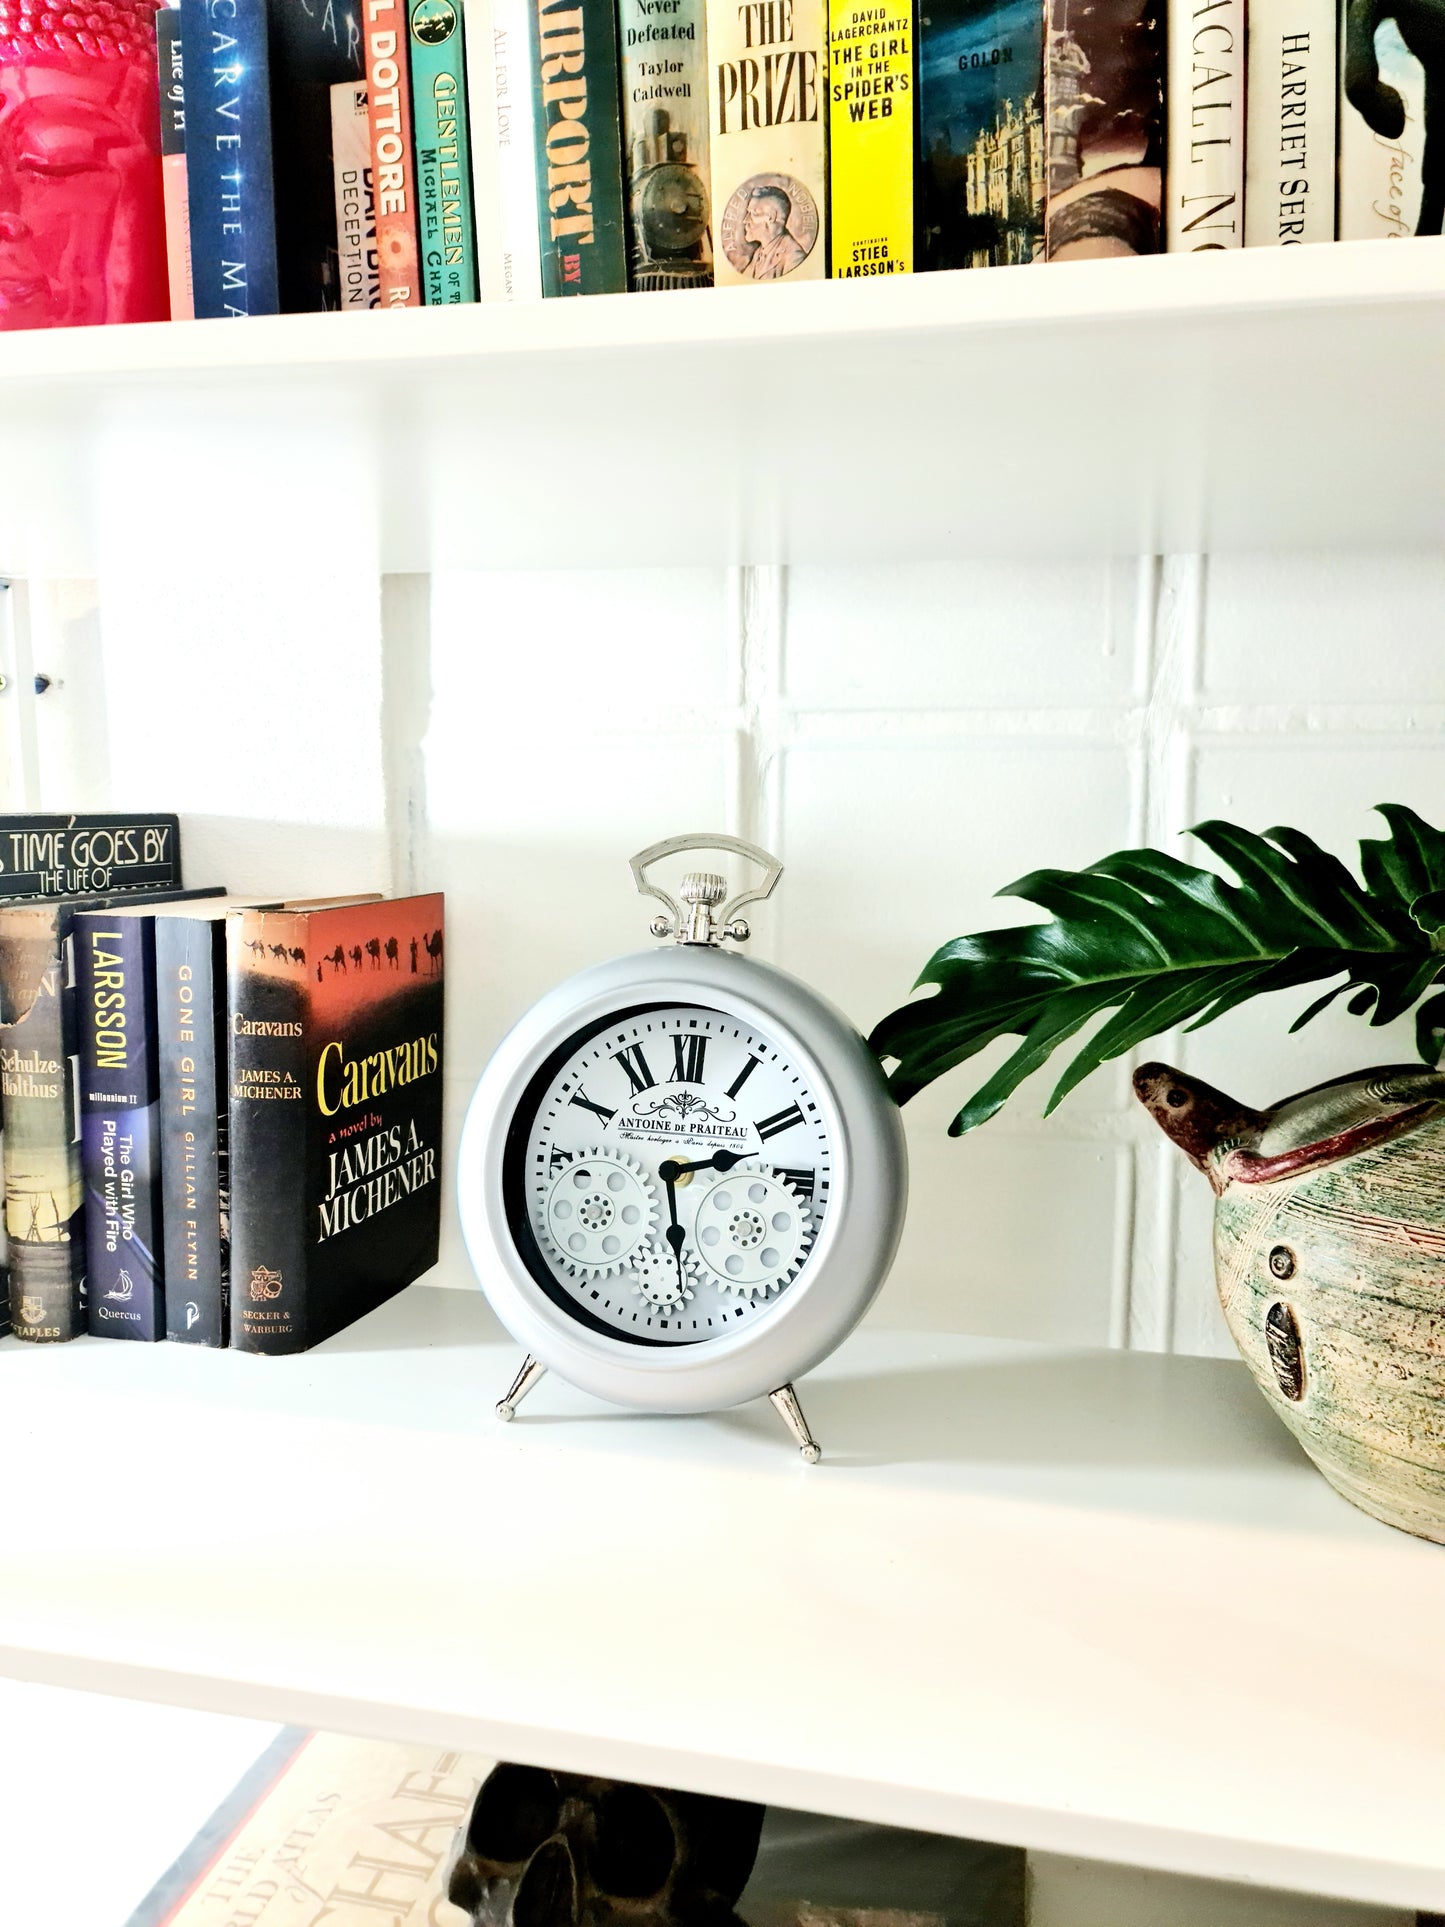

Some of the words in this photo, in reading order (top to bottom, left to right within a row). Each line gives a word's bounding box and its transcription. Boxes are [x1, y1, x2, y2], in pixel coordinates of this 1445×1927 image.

[636, 0, 682, 18] Never
[738, 0, 794, 48] THE
[852, 8, 887, 24] DAVID
[627, 23, 696, 47] Defeated
[831, 19, 909, 42] LAGERCRANTZ
[639, 59, 684, 76] Taylor
[833, 45, 863, 65] THE
[870, 38, 909, 59] GIRL
[211, 0, 243, 152] CARVE
[851, 66, 863, 78] IN
[868, 60, 890, 74] THE
[633, 83, 691, 103] Caldwell
[718, 51, 819, 135] PRIZE
[833, 74, 909, 101] SPIDER'S
[1280, 31, 1311, 170] HARRIET
[369, 31, 407, 217] DOTTORE
[850, 97, 893, 123] WEB
[421, 149, 438, 240] MICHAEL
[432, 72, 464, 266] GENTLEMEN
[448, 271, 461, 288] OF
[220, 174, 243, 236] THE
[722, 187, 749, 252] ALFRED
[788, 183, 815, 234] NOBEL
[341, 170, 364, 304] DECEPTION
[852, 245, 888, 262] STIEG
[562, 254, 582, 285] BY
[9, 832, 66, 872] TIME
[71, 829, 139, 868] GOES
[144, 828, 169, 863] BY
[38, 870, 64, 893] THE
[67, 868, 89, 891] LIFE
[91, 867, 113, 889] OF
[92, 932, 128, 1069] LARSSON
[178, 965, 194, 1042] GONE
[232, 1012, 303, 1037] Caravans
[240, 1069, 280, 1083] JAMES
[284, 1070, 297, 1083] A.
[316, 1032, 438, 1117] Caravans
[609, 1041, 660, 1100] XI
[665, 1034, 713, 1085] XII
[1, 1073, 58, 1098] Holthus
[180, 1056, 196, 1116] GIRL
[233, 1086, 302, 1099] MICHENER
[328, 1132, 337, 1144] a
[340, 1120, 367, 1138] novel
[370, 1112, 383, 1128] by
[618, 1117, 672, 1131] ANTOINE
[674, 1123, 686, 1132] DE
[689, 1123, 748, 1138] PRAITEAU
[100, 1119, 117, 1178] Played
[119, 1134, 134, 1164] The
[325, 1125, 401, 1201] JAMES
[404, 1118, 424, 1156] A.
[120, 1169, 135, 1200] Girl
[184, 1131, 198, 1209] GILLIAN
[105, 1181, 120, 1217] with
[317, 1148, 436, 1244] MICHENER
[106, 1219, 120, 1253] Fire
[121, 1202, 135, 1241] Who
[187, 1220, 198, 1280] FLYNN
[98, 1306, 142, 1321] Quercus
[242, 1310, 280, 1320] SECKER
[283, 1311, 291, 1319] &
[243, 1323, 294, 1334] WARBURG
